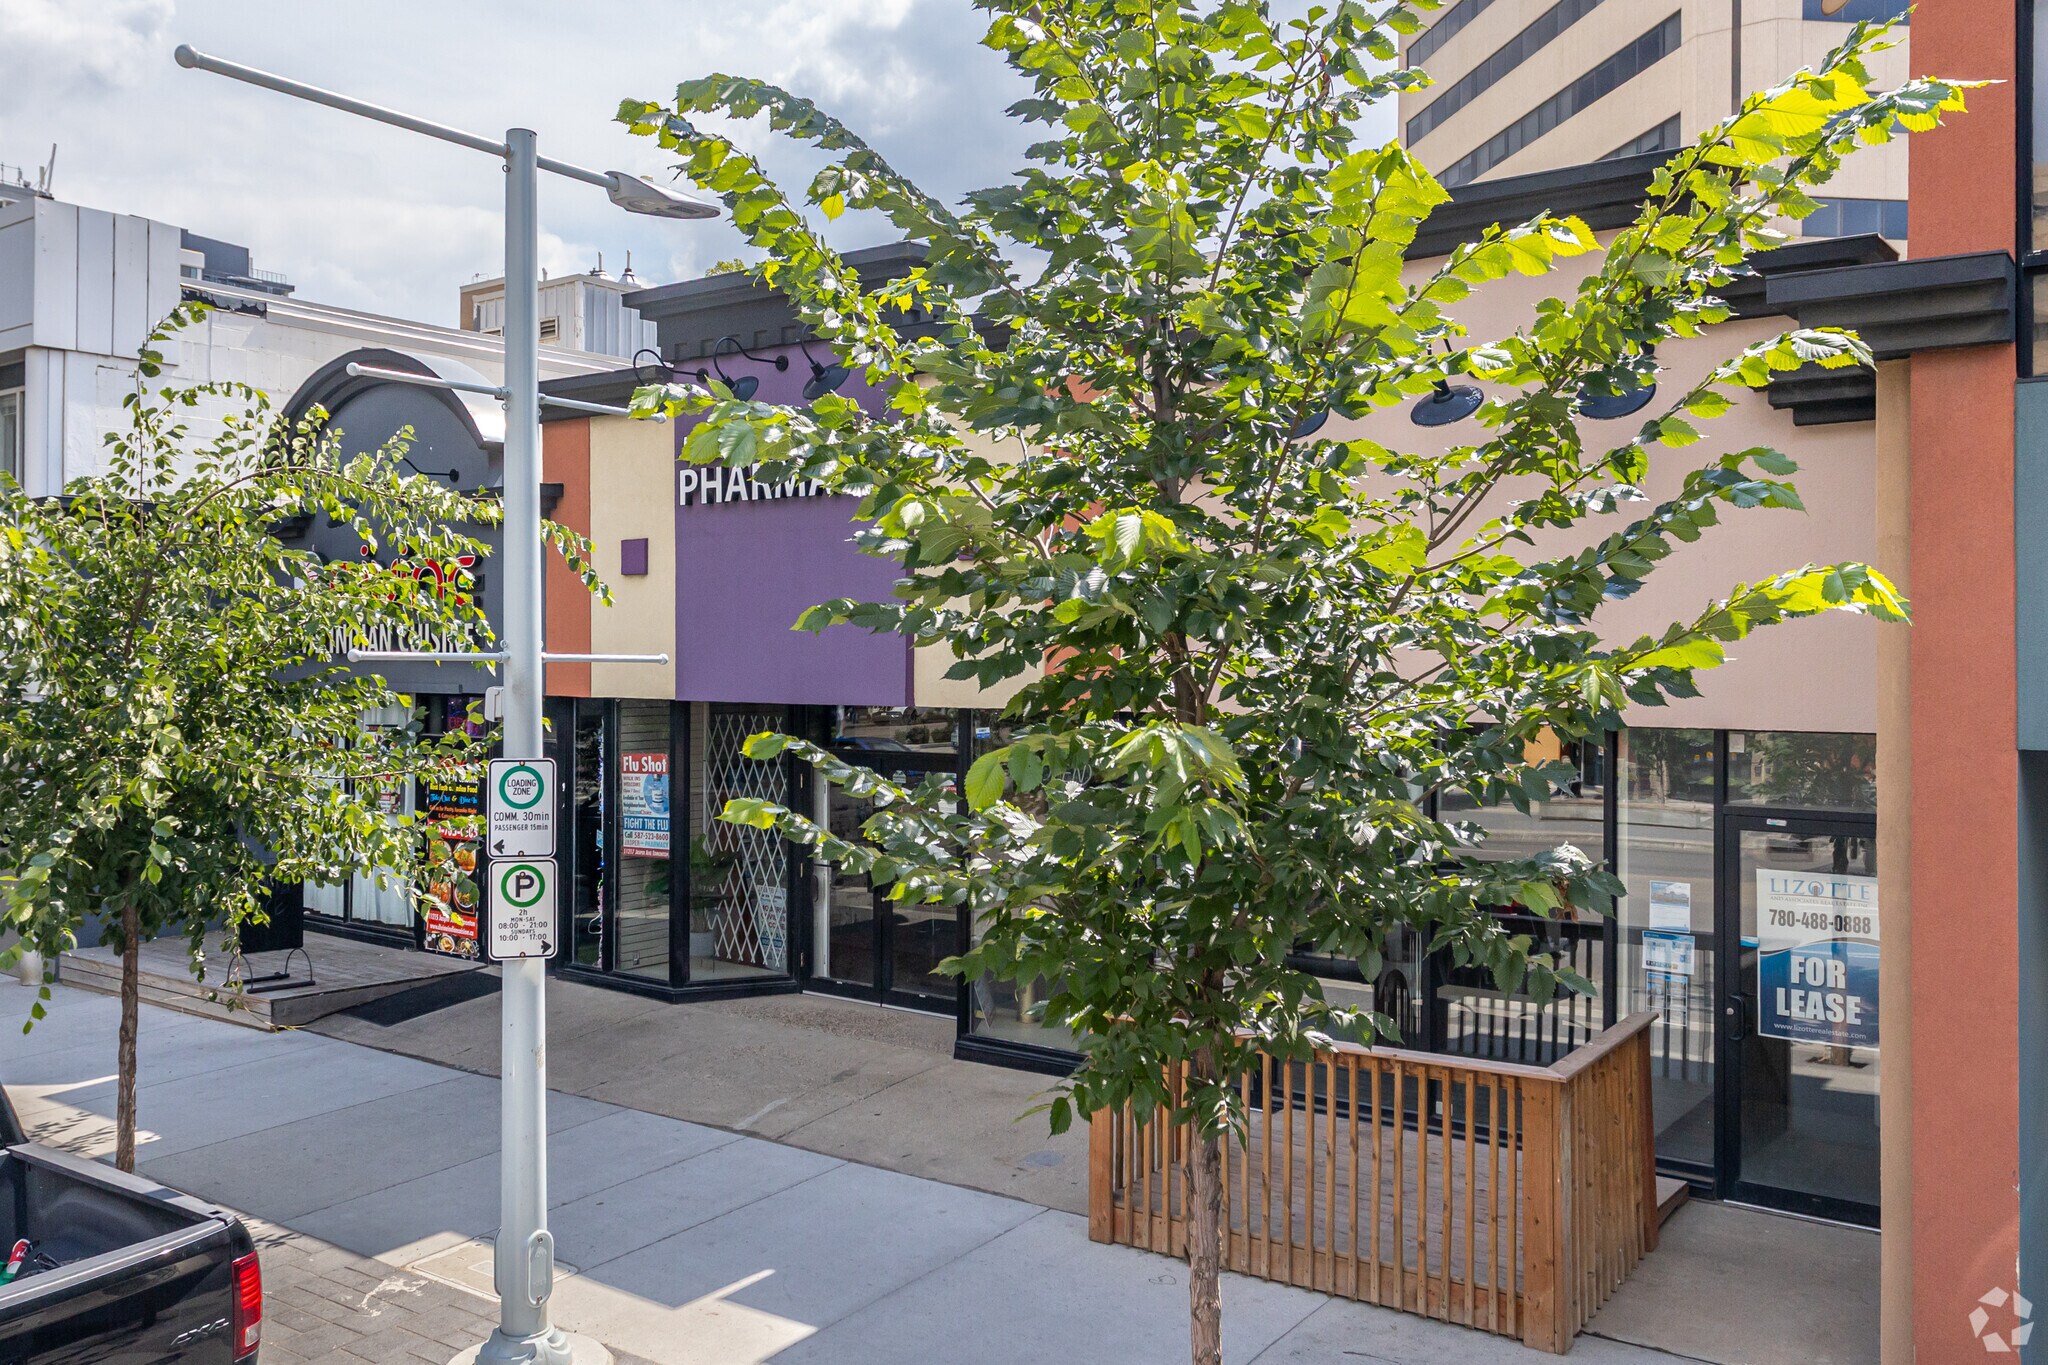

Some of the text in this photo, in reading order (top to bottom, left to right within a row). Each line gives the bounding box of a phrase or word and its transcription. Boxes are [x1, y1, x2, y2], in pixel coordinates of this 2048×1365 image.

[623, 755, 667, 773] Flu Shot
[507, 779, 537, 788] LOADING
[512, 788, 531, 796] ZONE
[493, 811, 550, 822] COMM. 30min
[624, 817, 669, 831] FIGHT THE FLU
[625, 831, 669, 841] Call 587-523-8600
[515, 874, 534, 898] P
[1769, 878, 1870, 900] LIZOTTE
[1768, 908, 1871, 934] 780-488-0888
[499, 934, 519, 942] 10:00
[529, 933, 547, 941] 17:00
[1790, 955, 1847, 990] FOR
[1775, 986, 1862, 1026] LEASE
[1773, 1022, 1867, 1041] www.lizotterealestate.com
